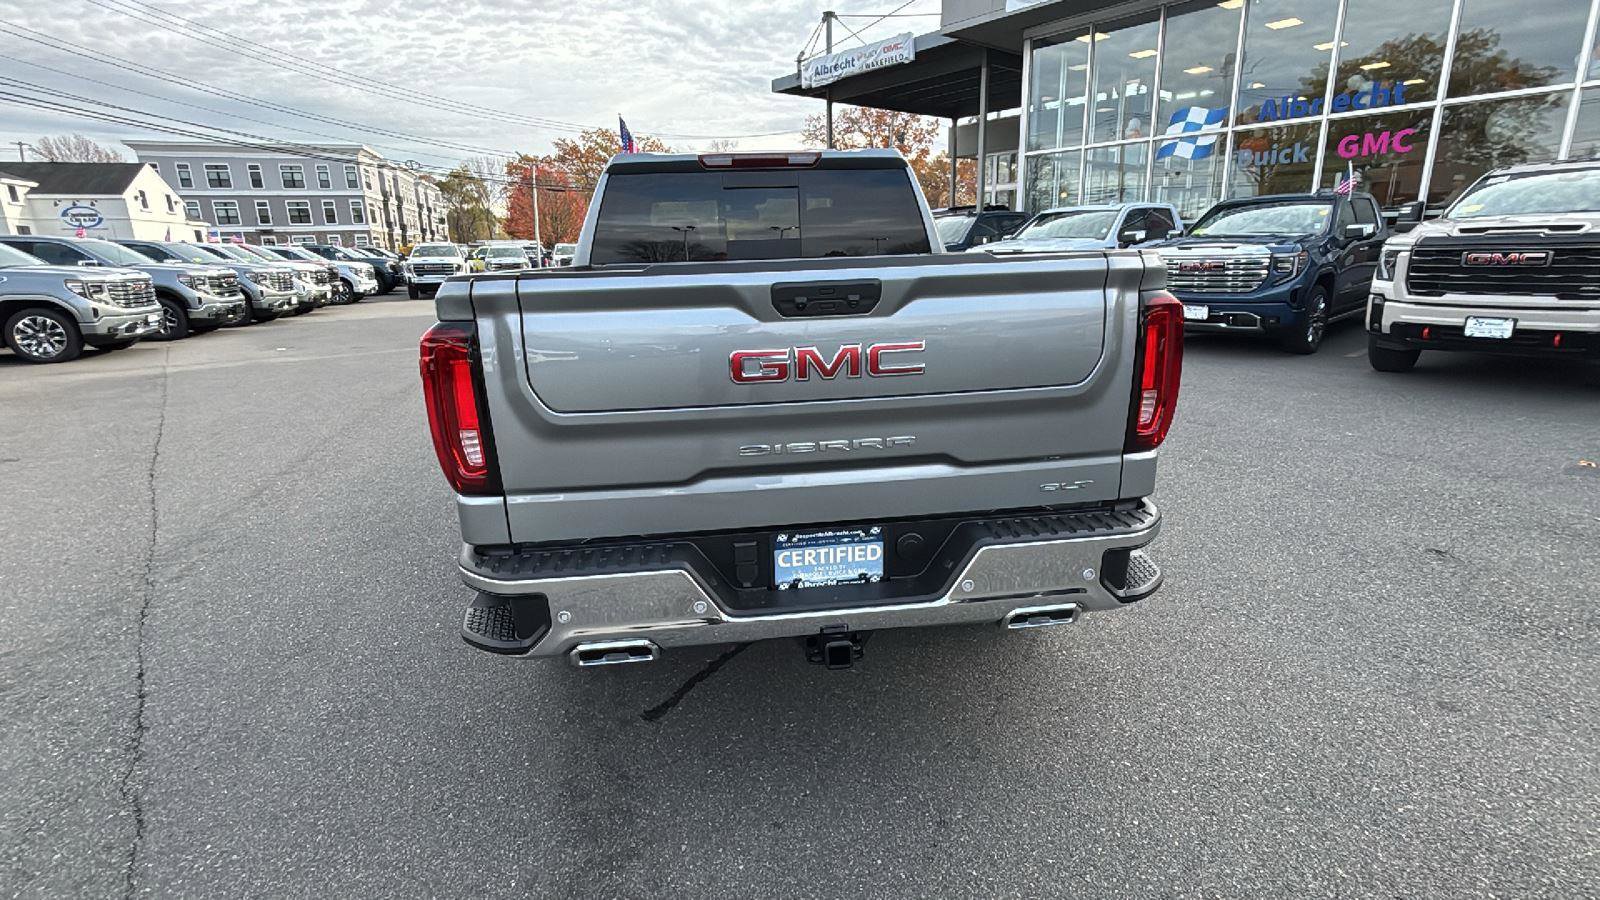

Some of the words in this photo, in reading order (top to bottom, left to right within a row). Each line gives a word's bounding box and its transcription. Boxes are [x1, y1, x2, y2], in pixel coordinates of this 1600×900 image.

[814, 56, 856, 77] Albrecht
[865, 53, 904, 70] WAKEFIELD
[1258, 81, 1408, 121] Albrecht
[1337, 128, 1416, 159] GMC
[1236, 142, 1310, 168] Buick
[1466, 252, 1547, 265] GMC
[729, 339, 926, 385] GMC
[738, 435, 917, 456] SIERRA
[1039, 480, 1094, 491] SLT
[777, 544, 882, 568] CERTIFIED
